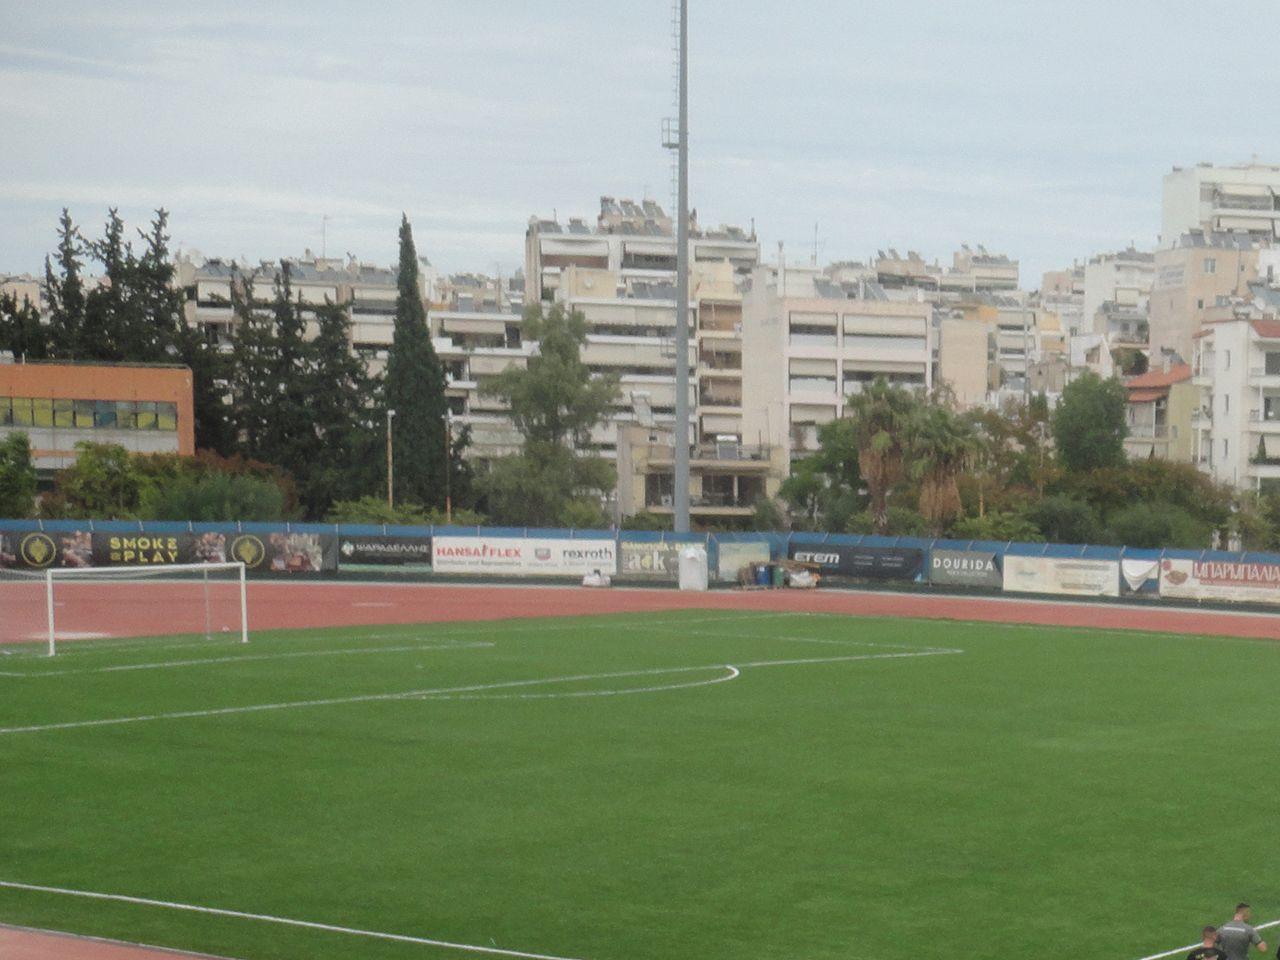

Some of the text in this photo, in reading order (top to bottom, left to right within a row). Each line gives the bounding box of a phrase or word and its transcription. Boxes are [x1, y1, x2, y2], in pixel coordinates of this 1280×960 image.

[110, 537, 178, 550] SMOKE
[562, 547, 613, 560] rexroth
[933, 557, 994, 576] DOURIDA
